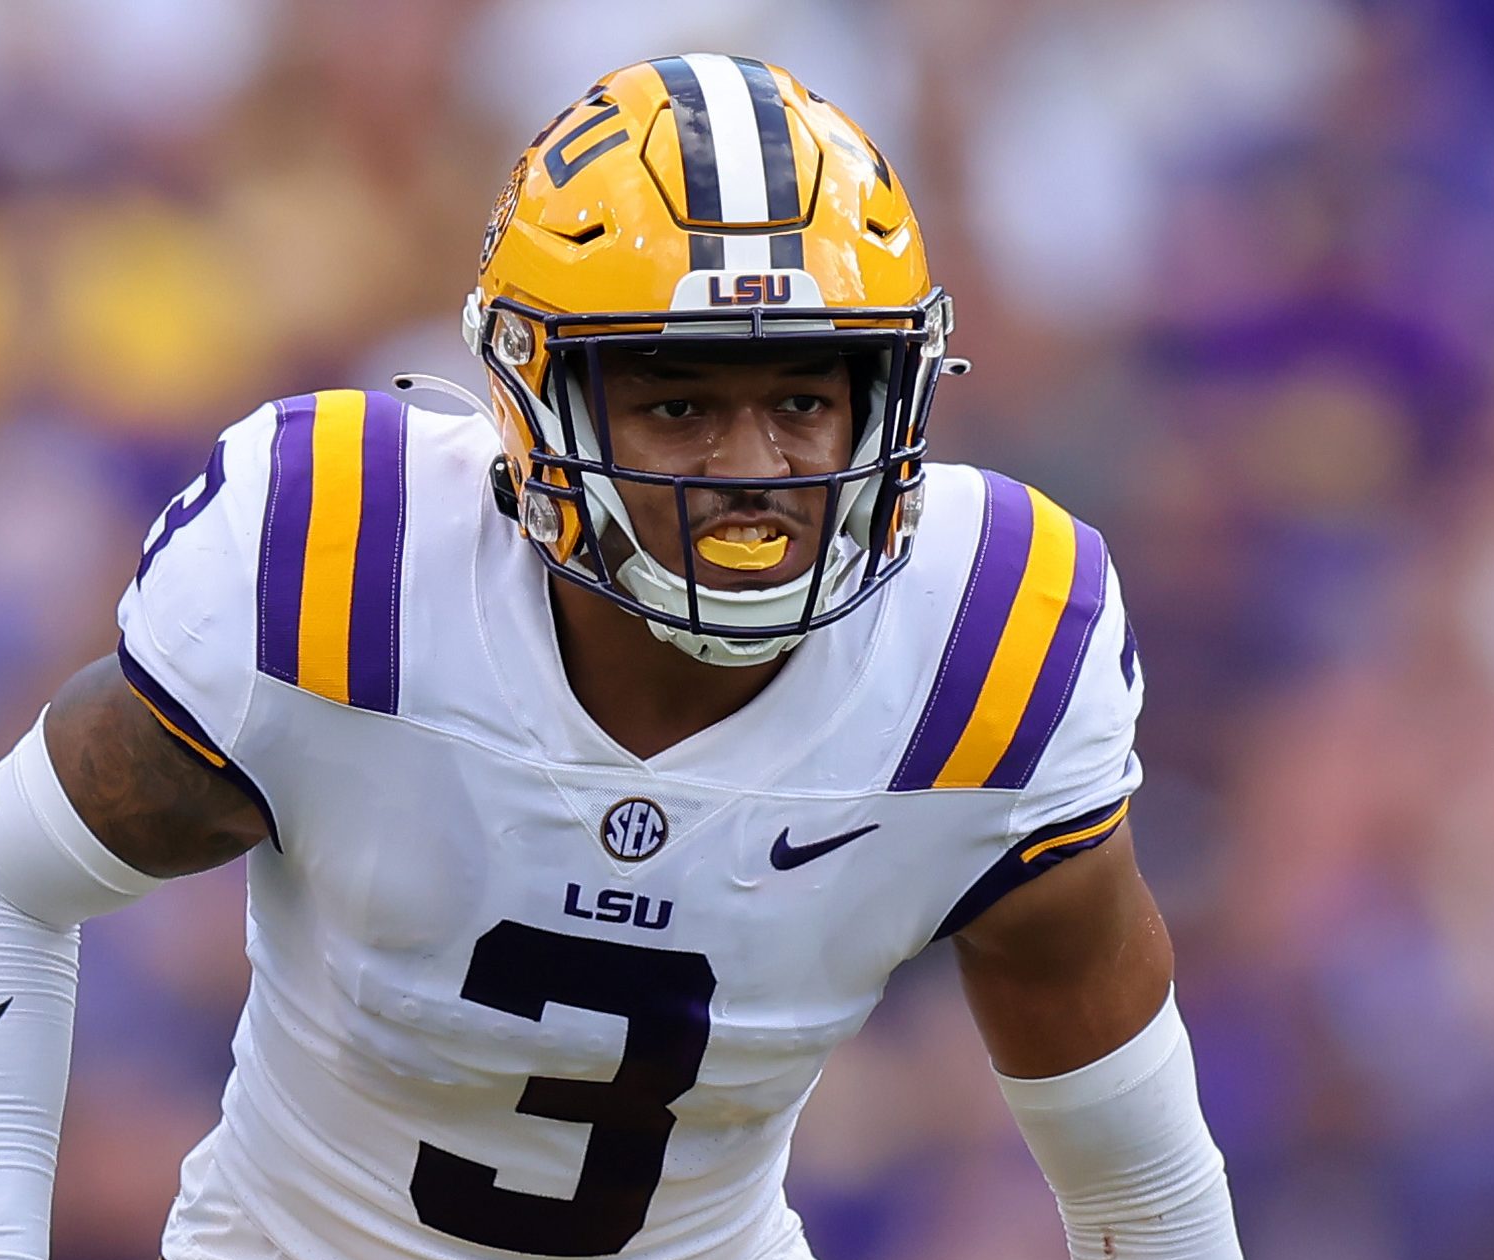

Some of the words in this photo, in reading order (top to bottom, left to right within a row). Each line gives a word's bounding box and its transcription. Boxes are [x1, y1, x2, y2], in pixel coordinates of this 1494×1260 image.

[708, 274, 792, 306] LSU
[605, 800, 665, 858] SEC
[564, 882, 674, 930] LSU
[410, 919, 717, 1257] 3
